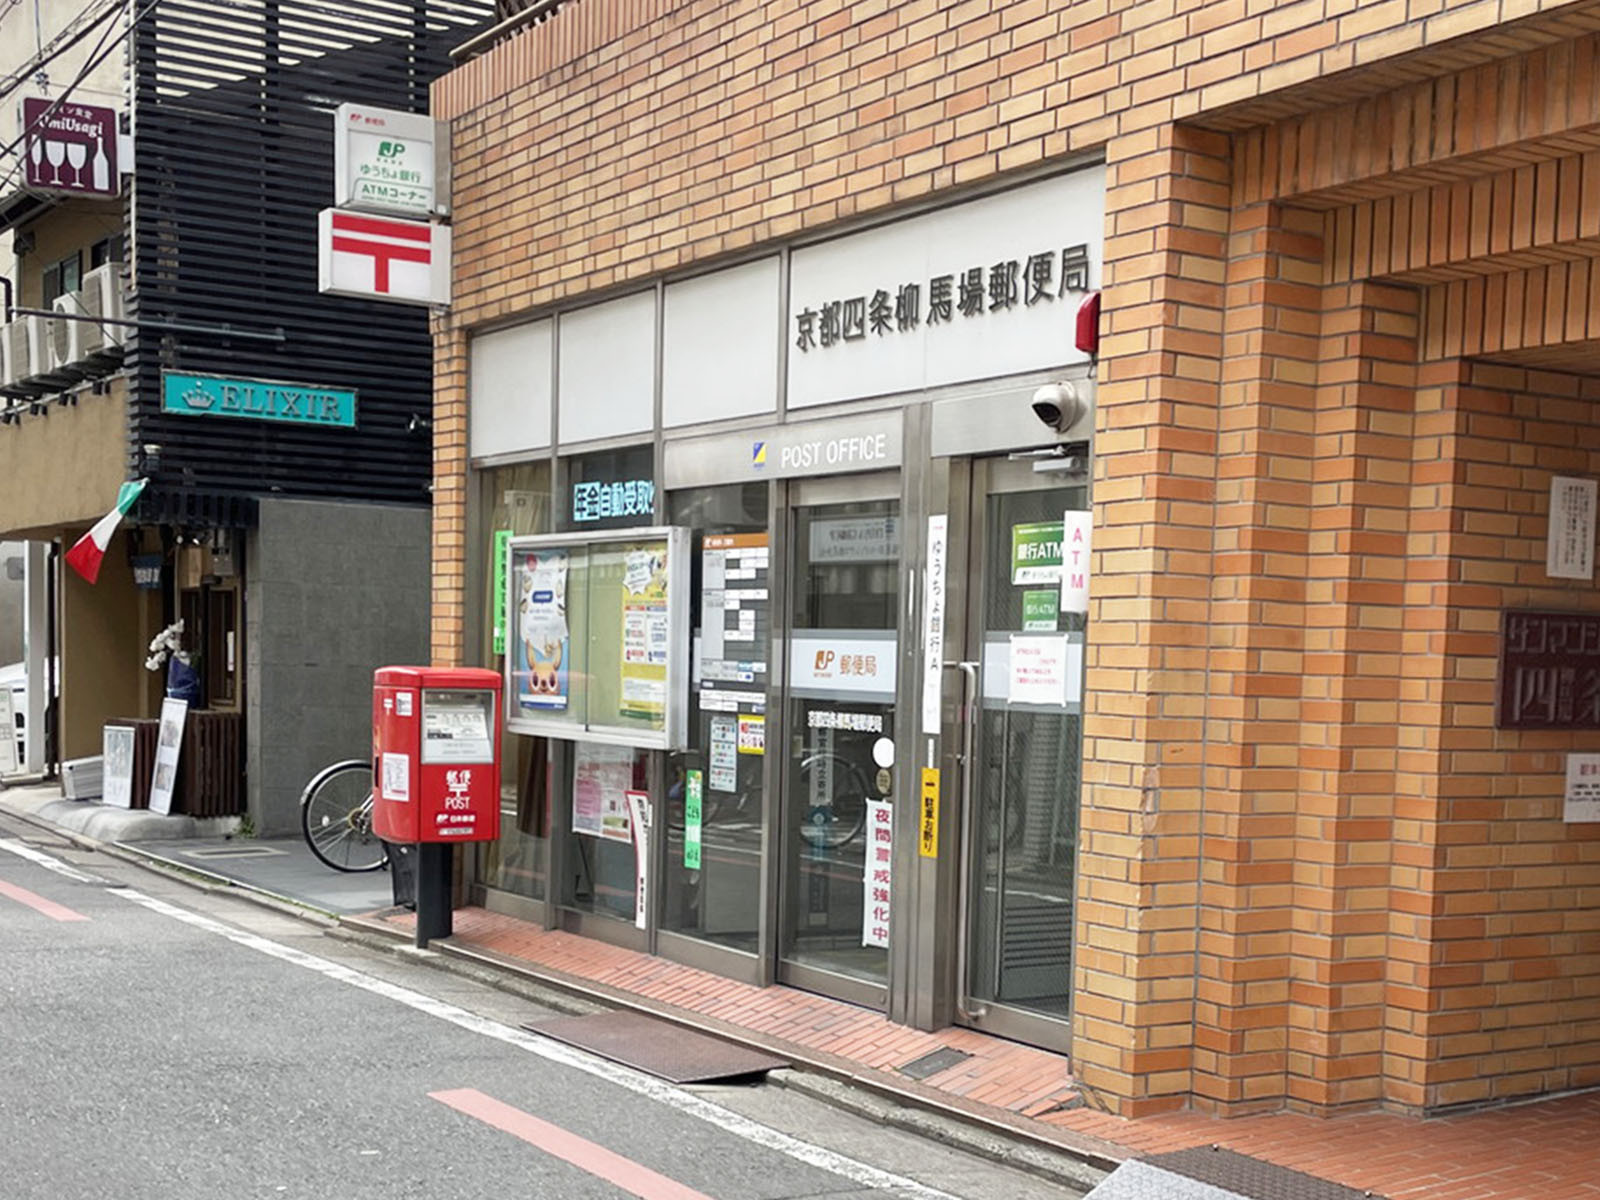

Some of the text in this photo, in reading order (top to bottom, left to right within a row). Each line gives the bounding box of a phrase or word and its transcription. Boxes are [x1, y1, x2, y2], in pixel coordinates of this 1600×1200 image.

[360, 164, 421, 183] ゆうちょ銀行
[361, 184, 427, 200] ATMコーナー
[795, 243, 1091, 352] 京都四条柳馬場郵便局
[220, 385, 342, 421] ELIXIR
[780, 434, 886, 470] POST OFFICE
[1070, 527, 1085, 590] ATM
[839, 654, 877, 677] 郵便局
[444, 797, 470, 810] POST
[872, 808, 892, 941] 夜間警戒強化中
